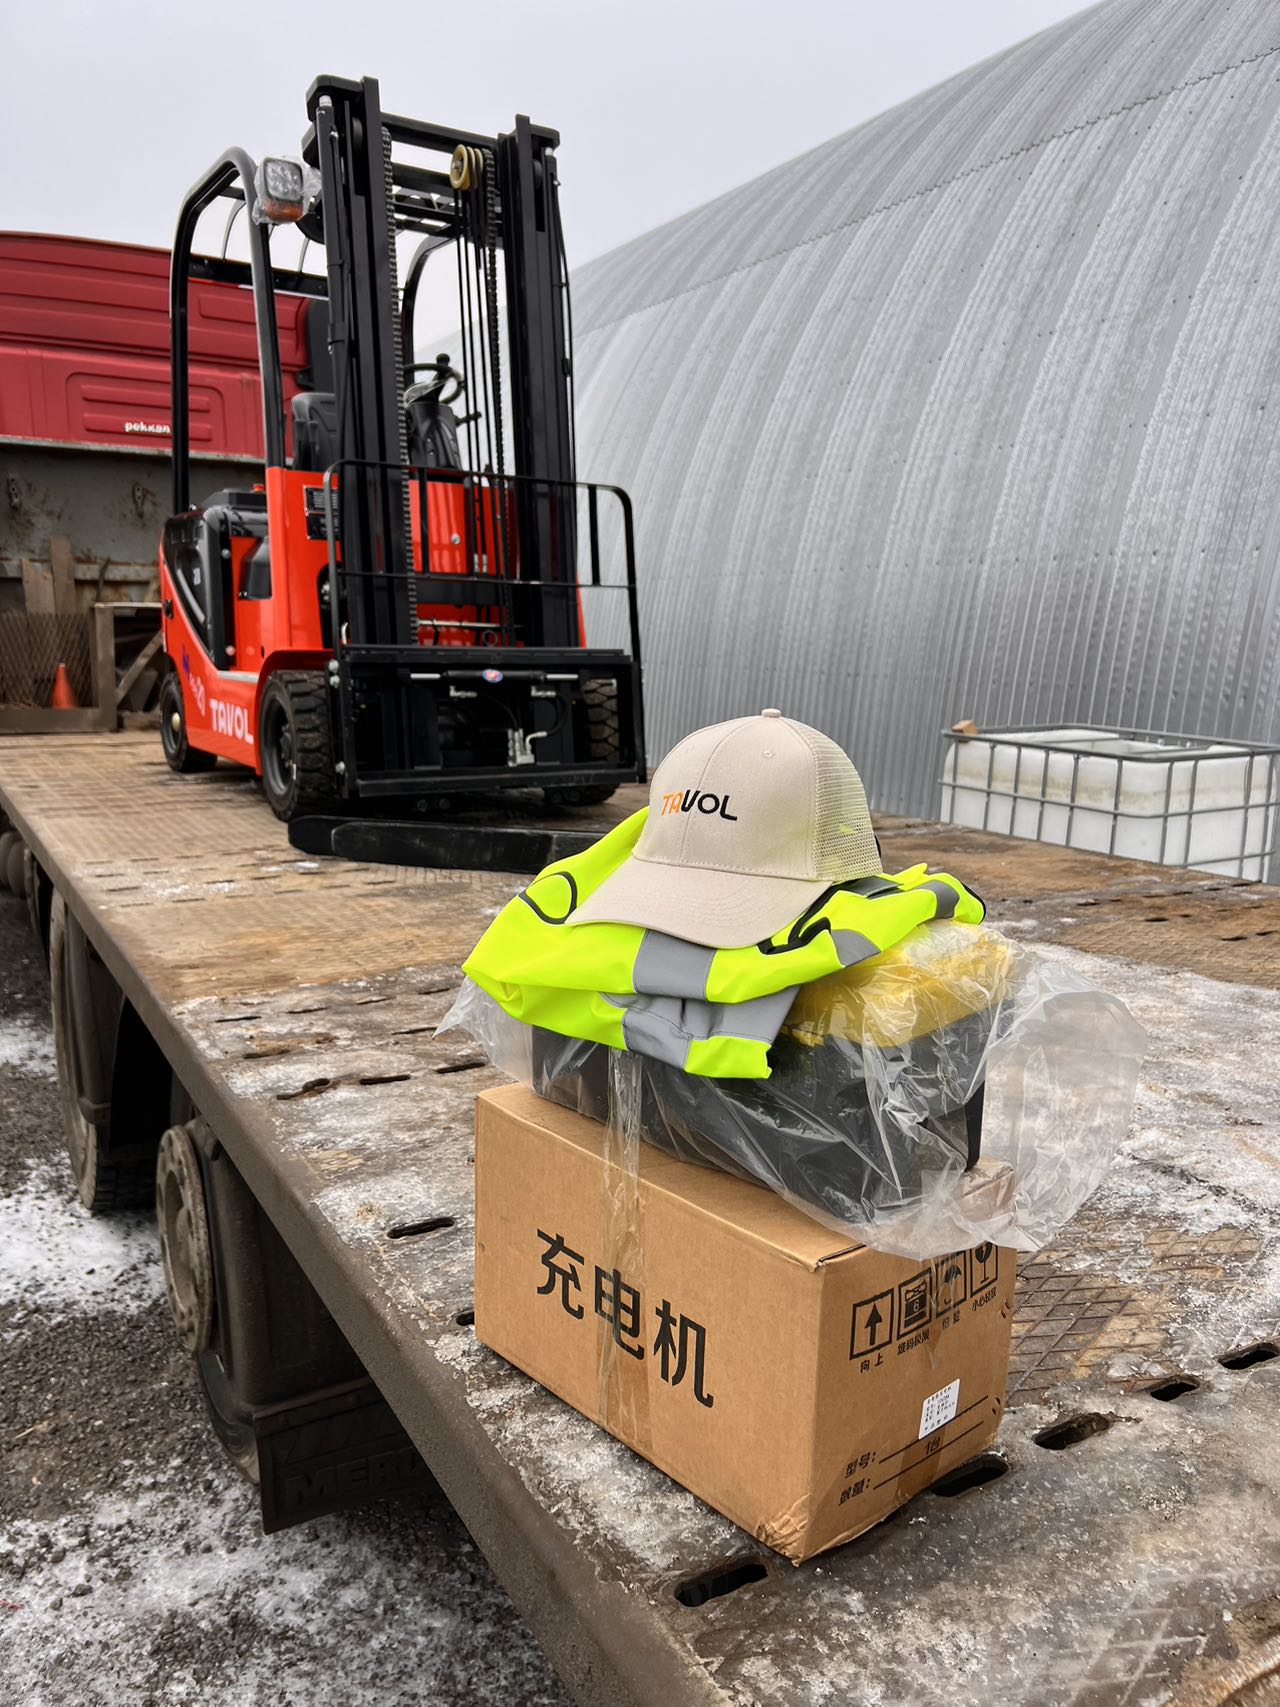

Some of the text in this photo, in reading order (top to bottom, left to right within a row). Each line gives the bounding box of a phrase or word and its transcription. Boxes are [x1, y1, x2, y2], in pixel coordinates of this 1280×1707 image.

[209, 698, 254, 745] TAVOL
[661, 789, 738, 822] TAVOL
[536, 1228, 714, 1409] 充电机
[913, 1300, 920, 1312] 6
[860, 1353, 884, 1374] 向上
